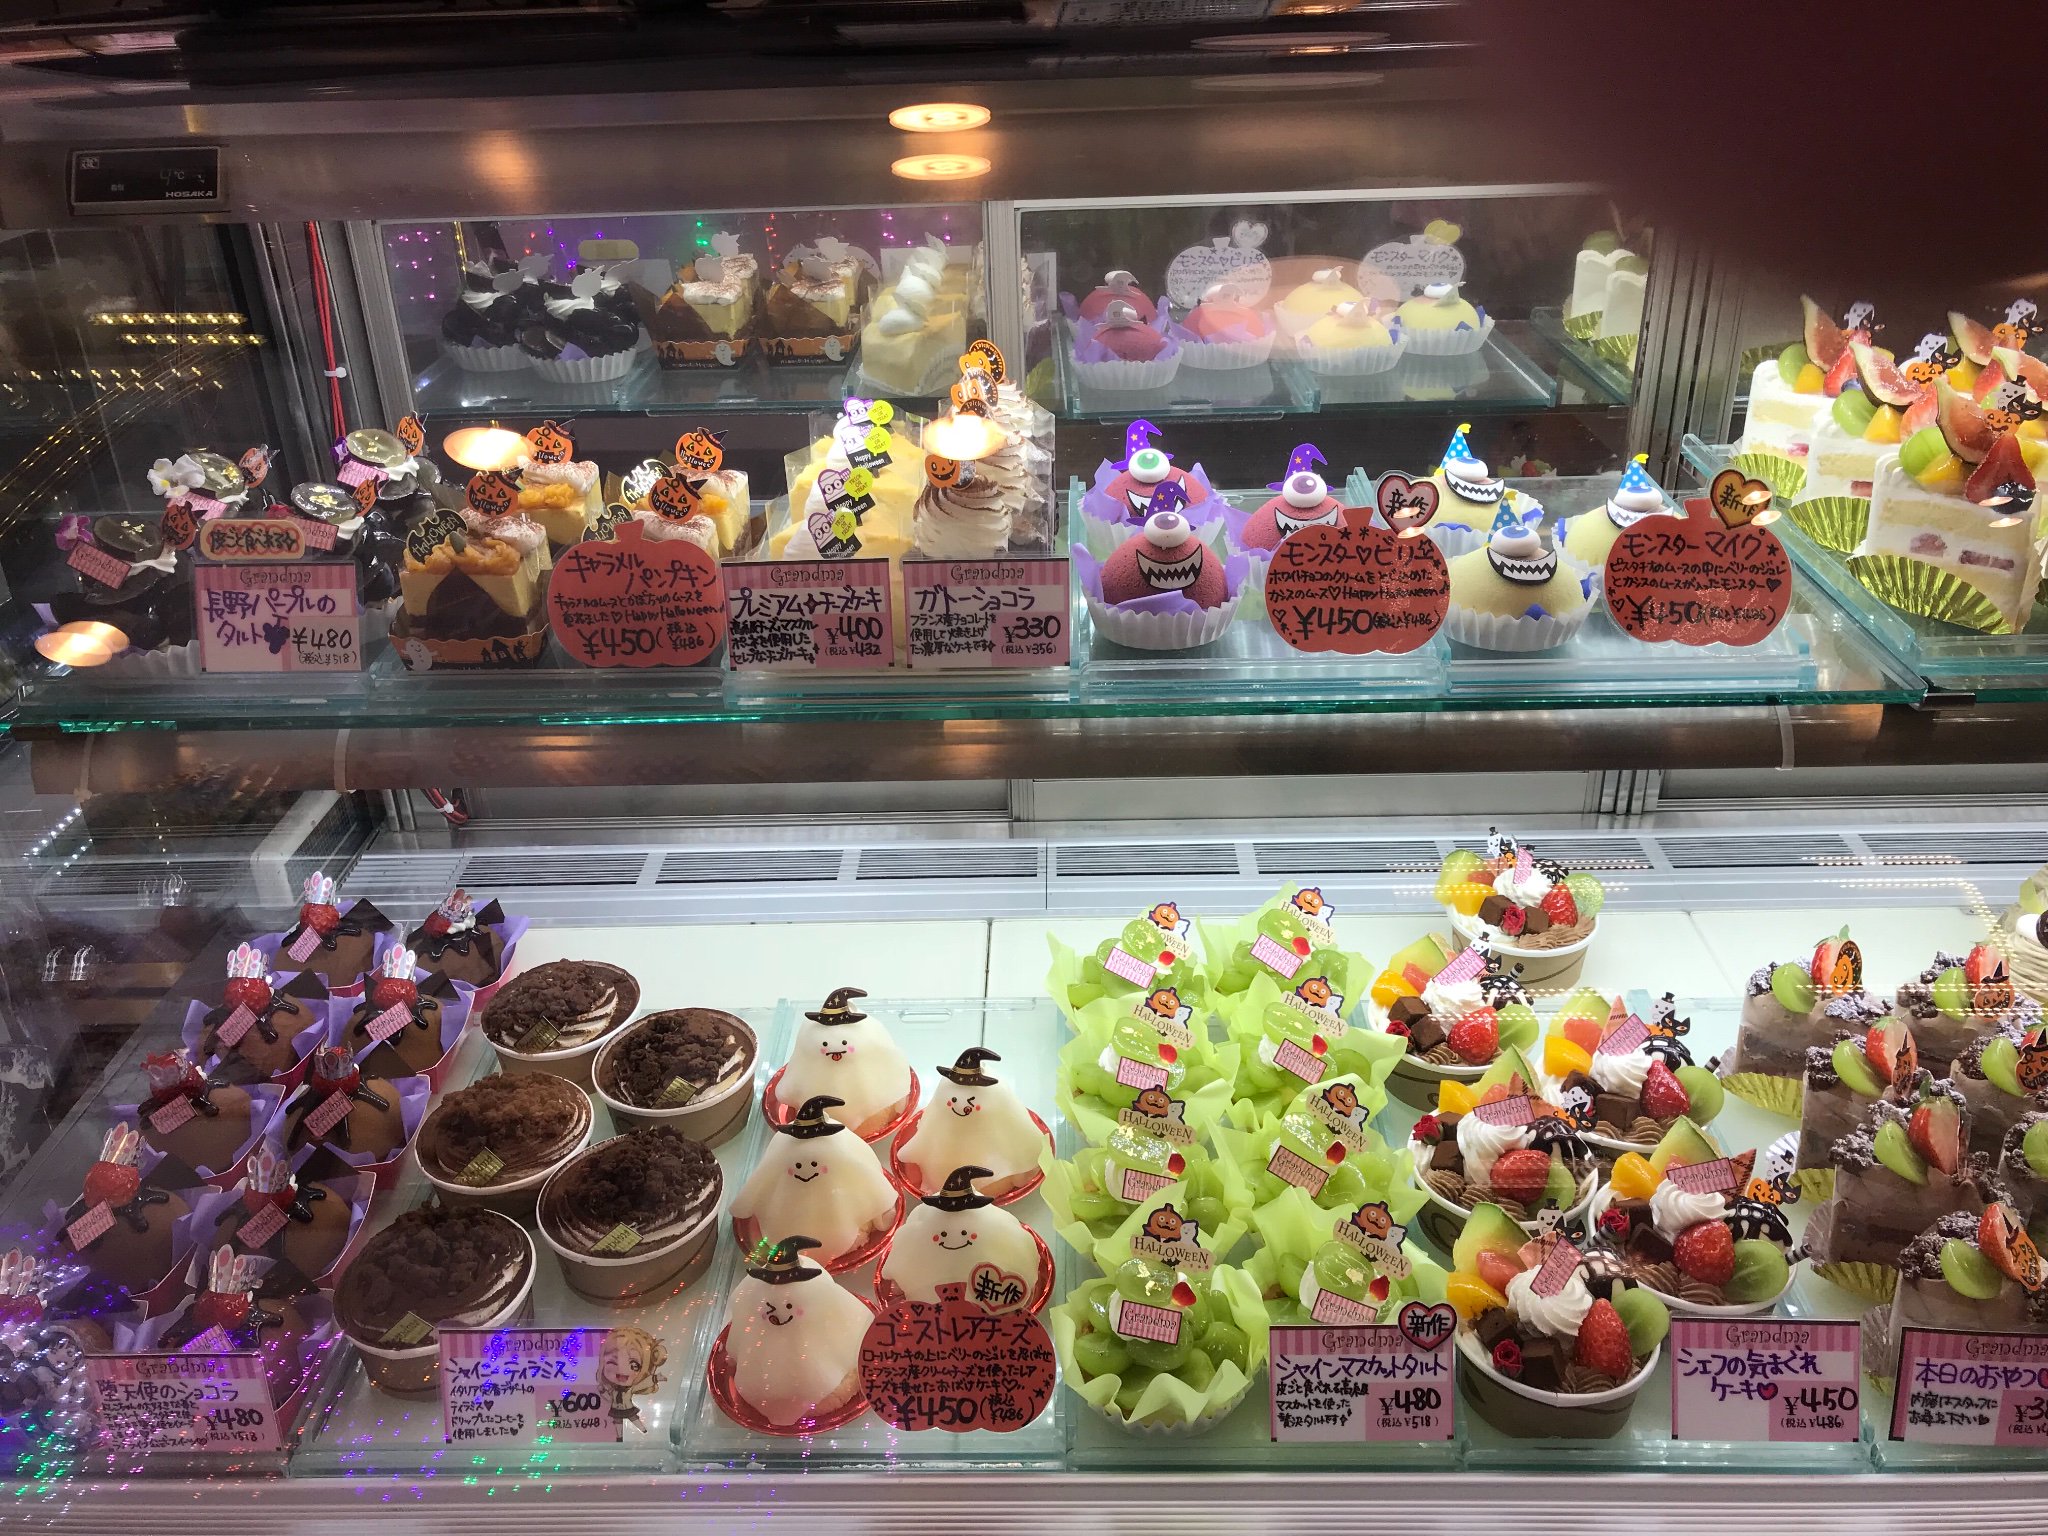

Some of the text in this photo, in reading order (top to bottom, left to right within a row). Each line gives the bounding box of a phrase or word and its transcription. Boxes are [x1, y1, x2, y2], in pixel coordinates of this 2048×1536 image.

[165, 190, 213, 198] HOSAKA
[680, 450, 714, 468] Halloween
[471, 493, 509, 514] Halloween
[653, 494, 688, 516] Halloween
[565, 550, 644, 583] キャラメル
[1281, 542, 1357, 567] モンスター
[240, 566, 311, 587] Grandma
[625, 560, 717, 594] パンプキン
[771, 564, 844, 587] Grandma
[951, 562, 1024, 584] Grandma
[915, 584, 1035, 614] ガトーショコラ
[217, 620, 263, 647] タルト
[826, 616, 883, 645] ¥400
[1003, 615, 1061, 643] ¥330
[1293, 606, 1373, 640] ¥450
[292, 627, 352, 652] ¥480
[577, 628, 656, 660] ¥450
[1281, 901, 1333, 940] HALLOWEEN
[1134, 1004, 1192, 1043] HALLOWEEN
[1285, 994, 1344, 1032] HALLOWEEN
[1122, 1063, 1165, 1083] Grandma
[1282, 1045, 1321, 1074] Grandma
[1124, 1111, 1192, 1140] HALLOWEEN
[1310, 1095, 1367, 1148] HALLOWEEN
[1277, 1154, 1321, 1186] Grandma
[1135, 1236, 1209, 1264] HALLOWEEN
[1338, 1221, 1408, 1272] HALLOWEEN
[975, 1270, 1023, 1304] 新作
[876, 1310, 1038, 1346] ゴーストレアチーズ
[1124, 1308, 1177, 1330] Grandma
[1407, 1309, 1451, 1338] 新作
[1322, 1328, 1404, 1352] Grandma
[1726, 1324, 1810, 1348] Grandma
[1966, 1336, 2048, 1358] Grandma
[136, 1358, 216, 1378] Grandma
[1276, 1353, 1448, 1380] シャインマスカットタルト
[1677, 1344, 1822, 1379] シェフの気まぐれ
[1916, 1358, 2037, 1390] 本日のおやつ
[1378, 1387, 1442, 1415] ¥480
[1711, 1375, 1757, 1401] ケーキ
[1783, 1387, 1858, 1415] ¥450
[550, 1391, 601, 1417] ¥600
[888, 1396, 978, 1431] ¥450
[203, 1408, 264, 1431] ¥480
